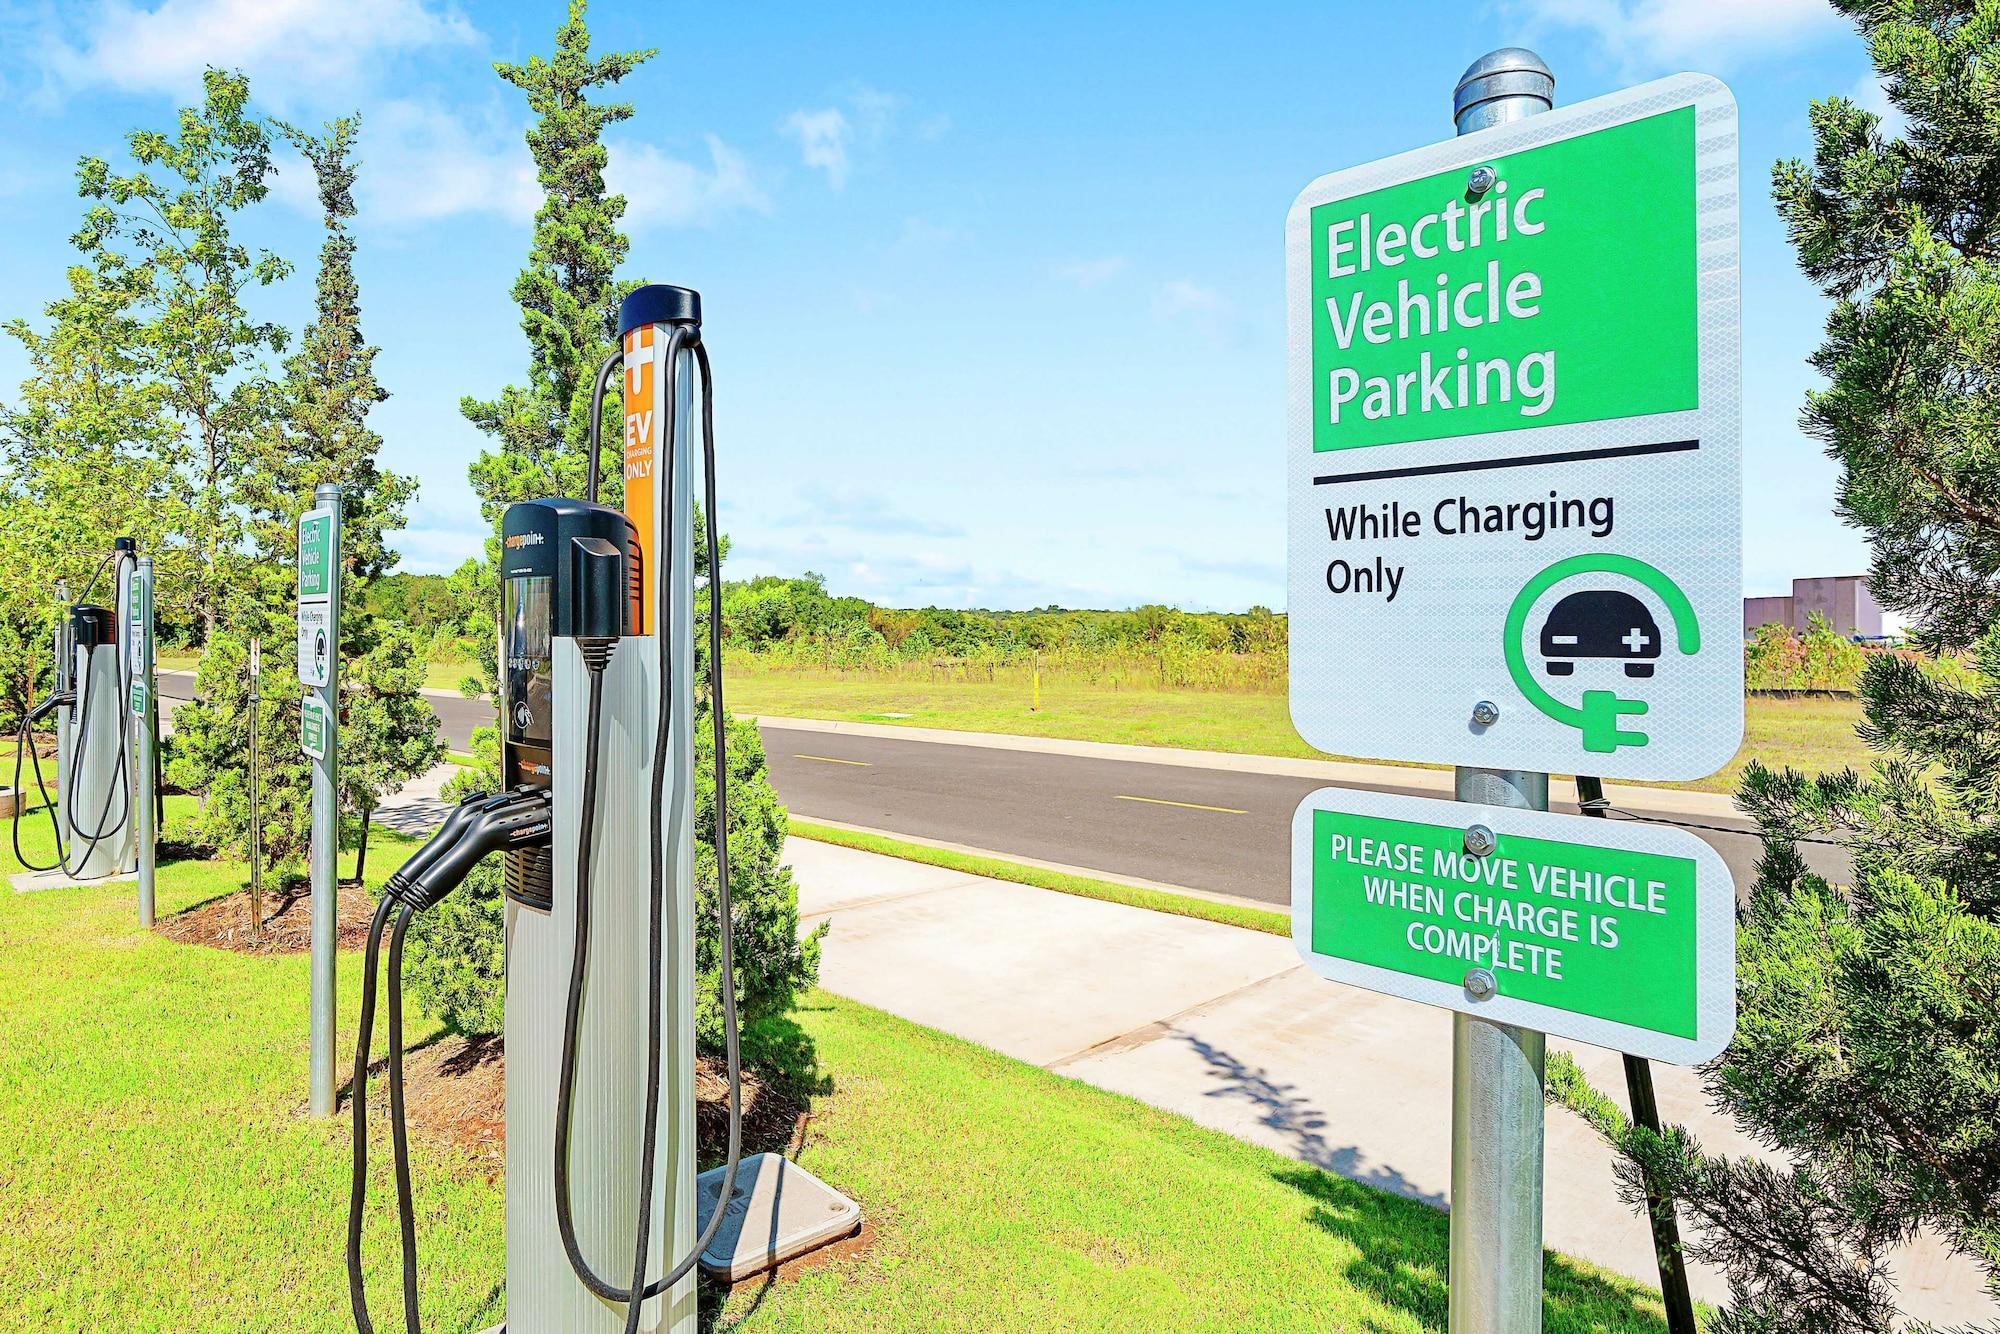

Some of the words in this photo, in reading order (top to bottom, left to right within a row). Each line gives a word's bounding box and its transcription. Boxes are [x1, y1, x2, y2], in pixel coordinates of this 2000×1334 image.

[1327, 182, 1546, 279] Electric
[1326, 260, 1542, 350] Vehicle
[1329, 348, 1556, 425] Parking
[626, 410, 653, 447] EV
[626, 459, 653, 481] ONLY
[302, 524, 321, 545] Electric
[1325, 502, 1421, 541] While
[1433, 490, 1615, 541] Charging
[301, 546, 320, 567] Vehicle
[301, 570, 321, 591] Parking
[1325, 555, 1404, 602] Only
[1331, 833, 1424, 875] PLEASE
[1432, 852, 1518, 893] MOVE
[1526, 863, 1667, 914] VEHICLE
[1363, 875, 1445, 916] WHEN
[1453, 890, 1578, 942] CHARGE
[1588, 914, 1619, 949] IS
[1406, 920, 1562, 981] COMPLETE
